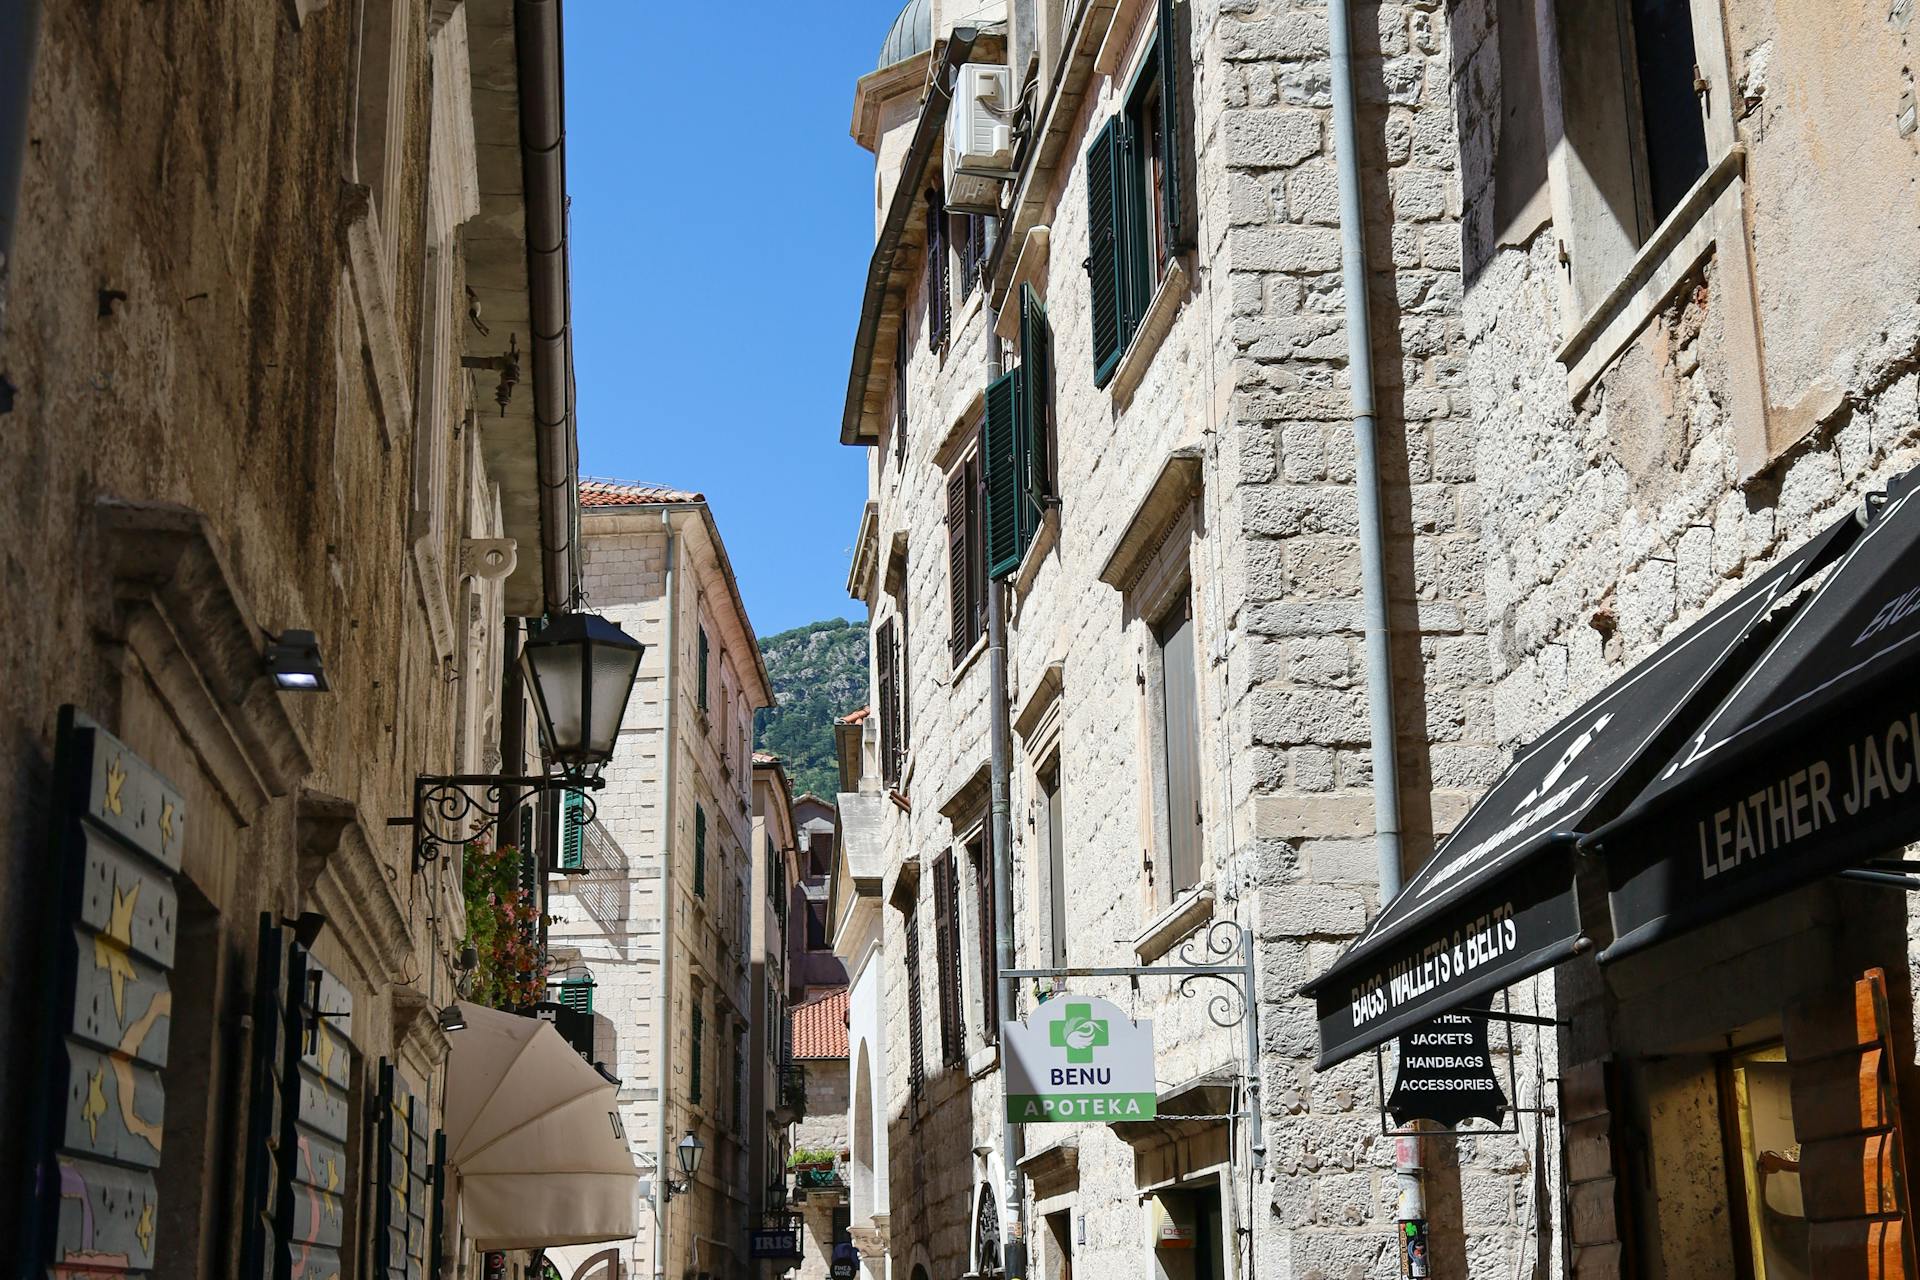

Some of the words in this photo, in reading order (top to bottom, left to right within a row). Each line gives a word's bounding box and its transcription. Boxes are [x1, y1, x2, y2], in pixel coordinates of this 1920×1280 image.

[1698, 760, 1836, 880] LEATHER
[1351, 973, 1388, 1028] BAGS,
[1389, 936, 1451, 1008] WALLETS
[1453, 930, 1465, 977] &
[1466, 901, 1517, 970] BELTS
[1410, 1033, 1473, 1045] JACKETS
[1406, 1056, 1484, 1069] HANDBAGS
[1051, 1067, 1111, 1086] BENU
[1400, 1079, 1494, 1091] ACCESSORIES
[1024, 1098, 1141, 1117] APOTEKA
[755, 1236, 793, 1250] IRIS
